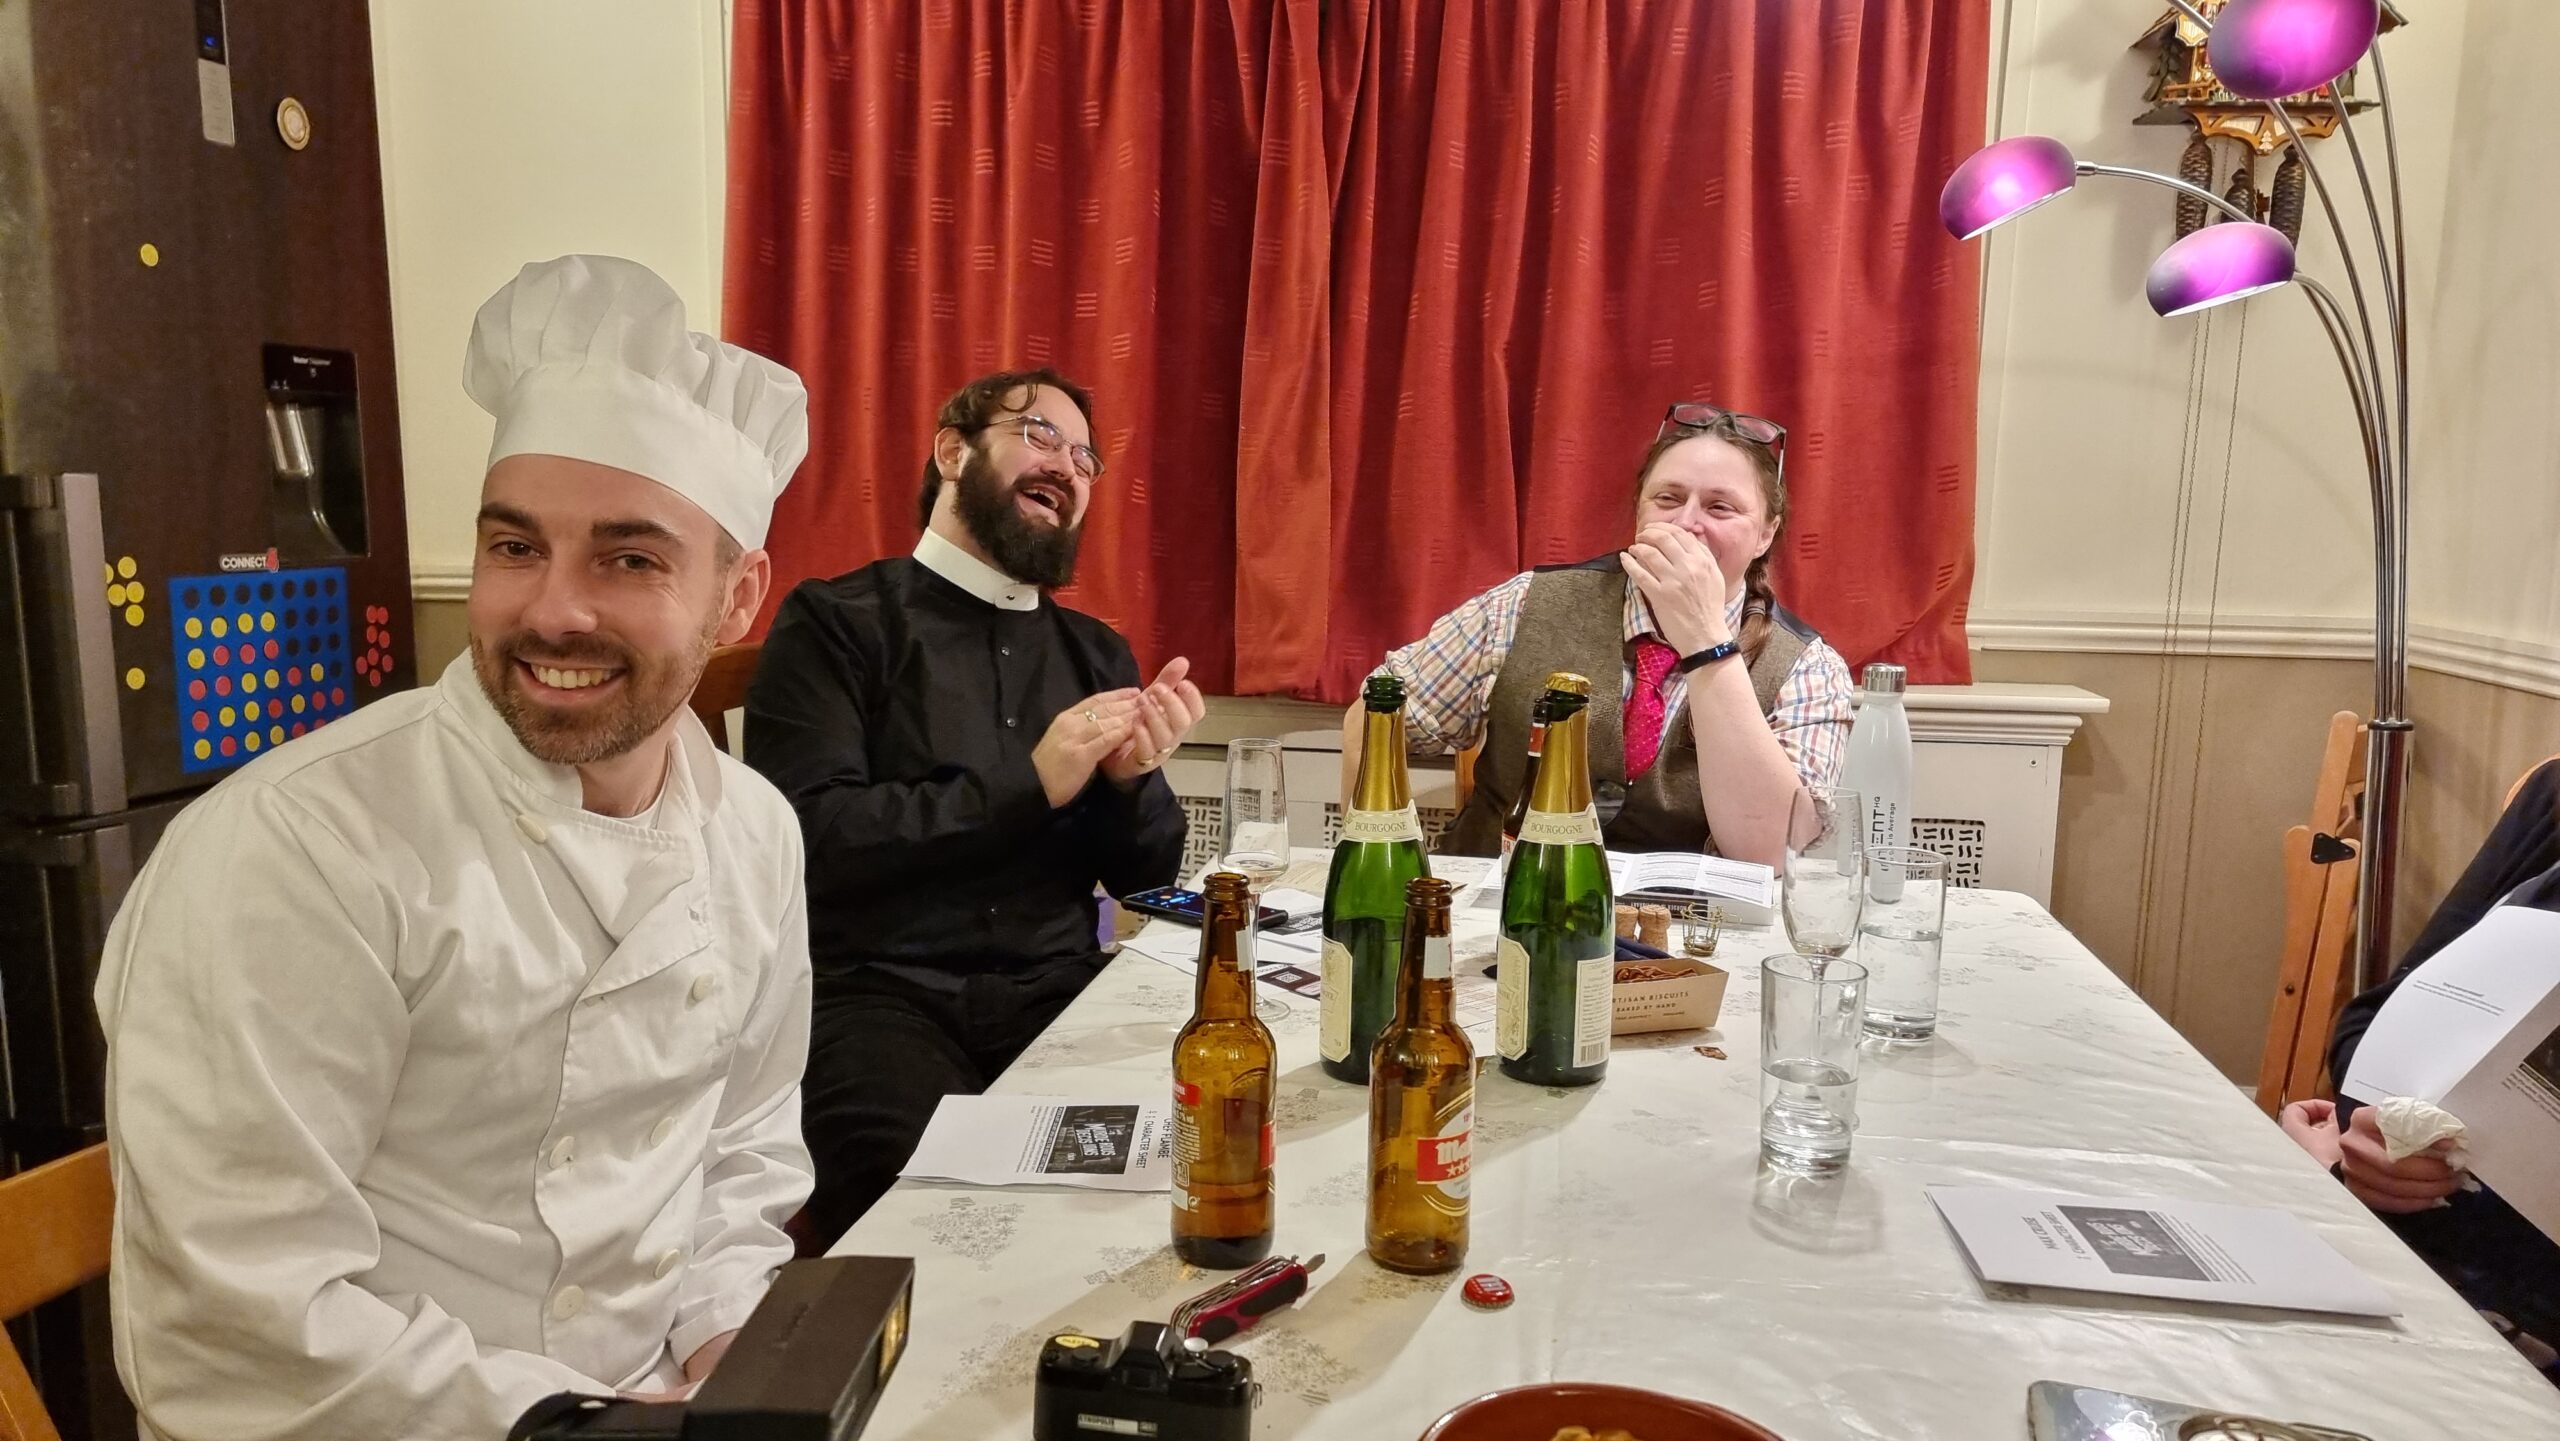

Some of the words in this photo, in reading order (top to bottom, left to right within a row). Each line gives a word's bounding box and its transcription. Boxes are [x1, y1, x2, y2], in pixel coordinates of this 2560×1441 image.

[221, 556, 267, 569] CONNECT
[1874, 796, 1881, 808] HQ
[1887, 802, 1897, 832] Average
[1355, 821, 1408, 833] BOURGOGNE
[1530, 822, 1584, 835] BOURGOGNE
[1611, 996, 1645, 1004] RTISAN
[1649, 991, 1689, 1000] BISCUITS
[1139, 1120, 1155, 1151] CHARACTER
[1136, 1151, 1149, 1169] SHEET
